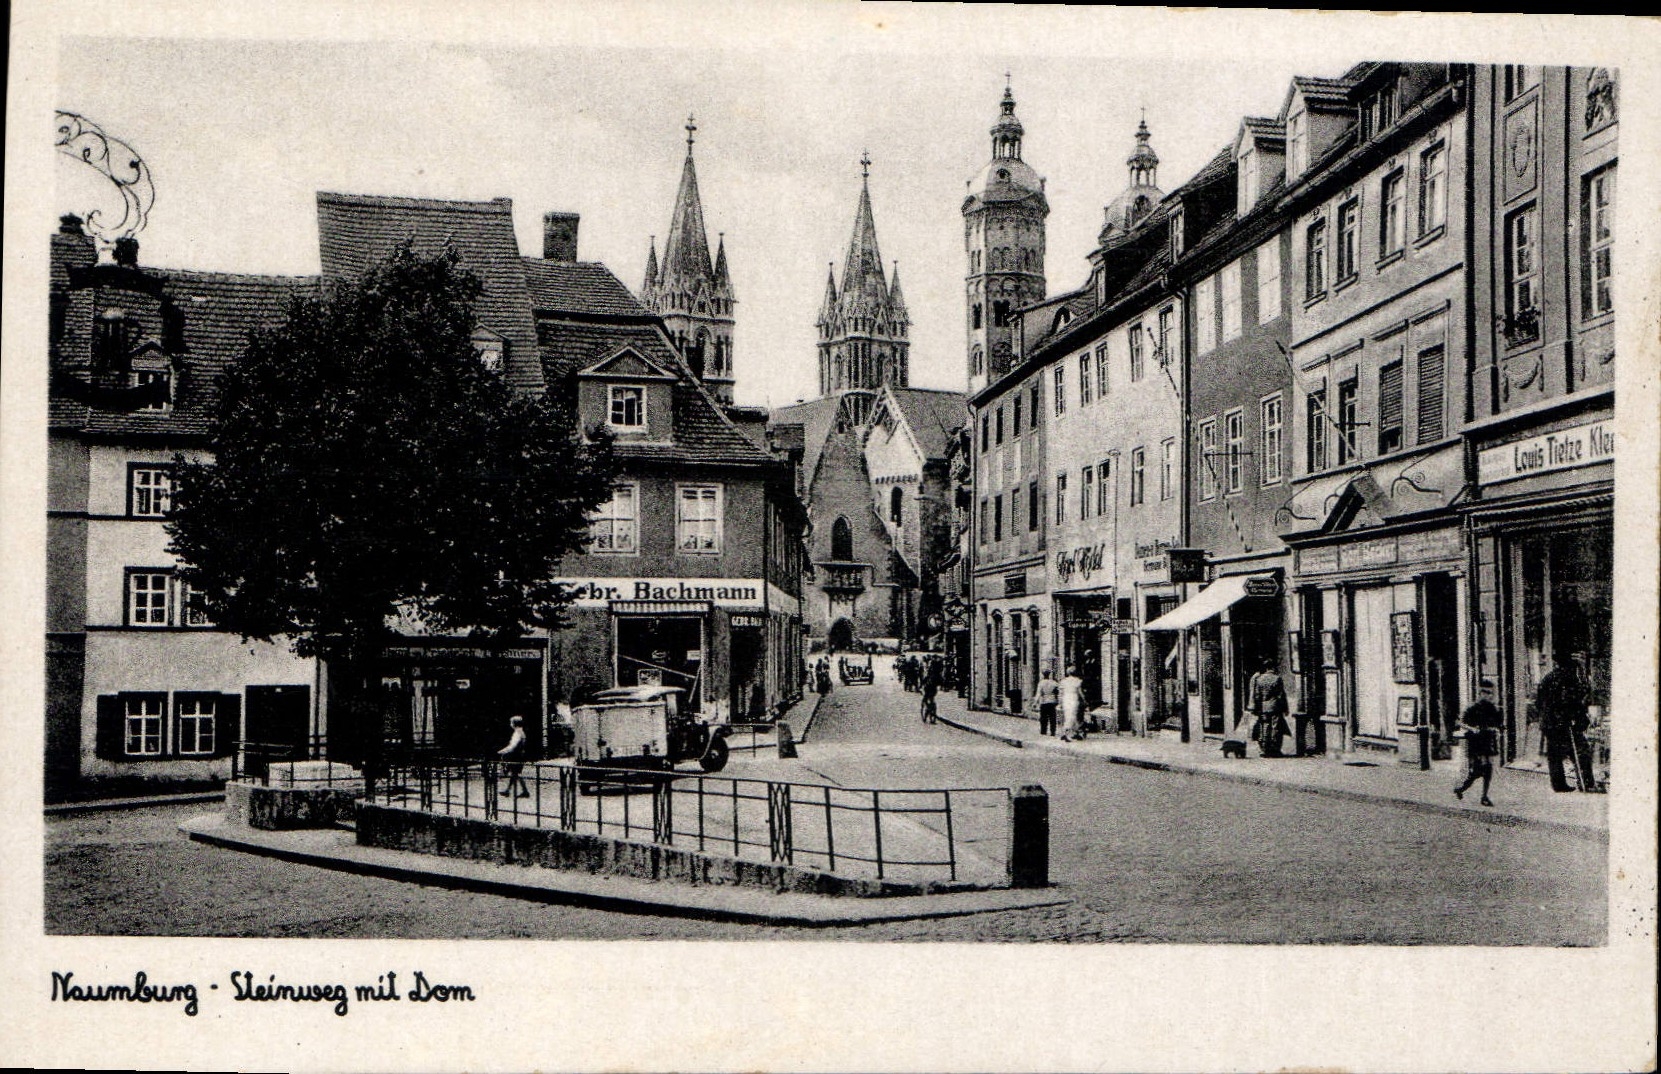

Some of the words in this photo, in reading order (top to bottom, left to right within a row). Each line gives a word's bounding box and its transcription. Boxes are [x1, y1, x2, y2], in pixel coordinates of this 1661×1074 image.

[1514, 443, 1545, 474] Louis
[1546, 435, 1583, 466] Tietze
[633, 582, 757, 600] Bachmann
